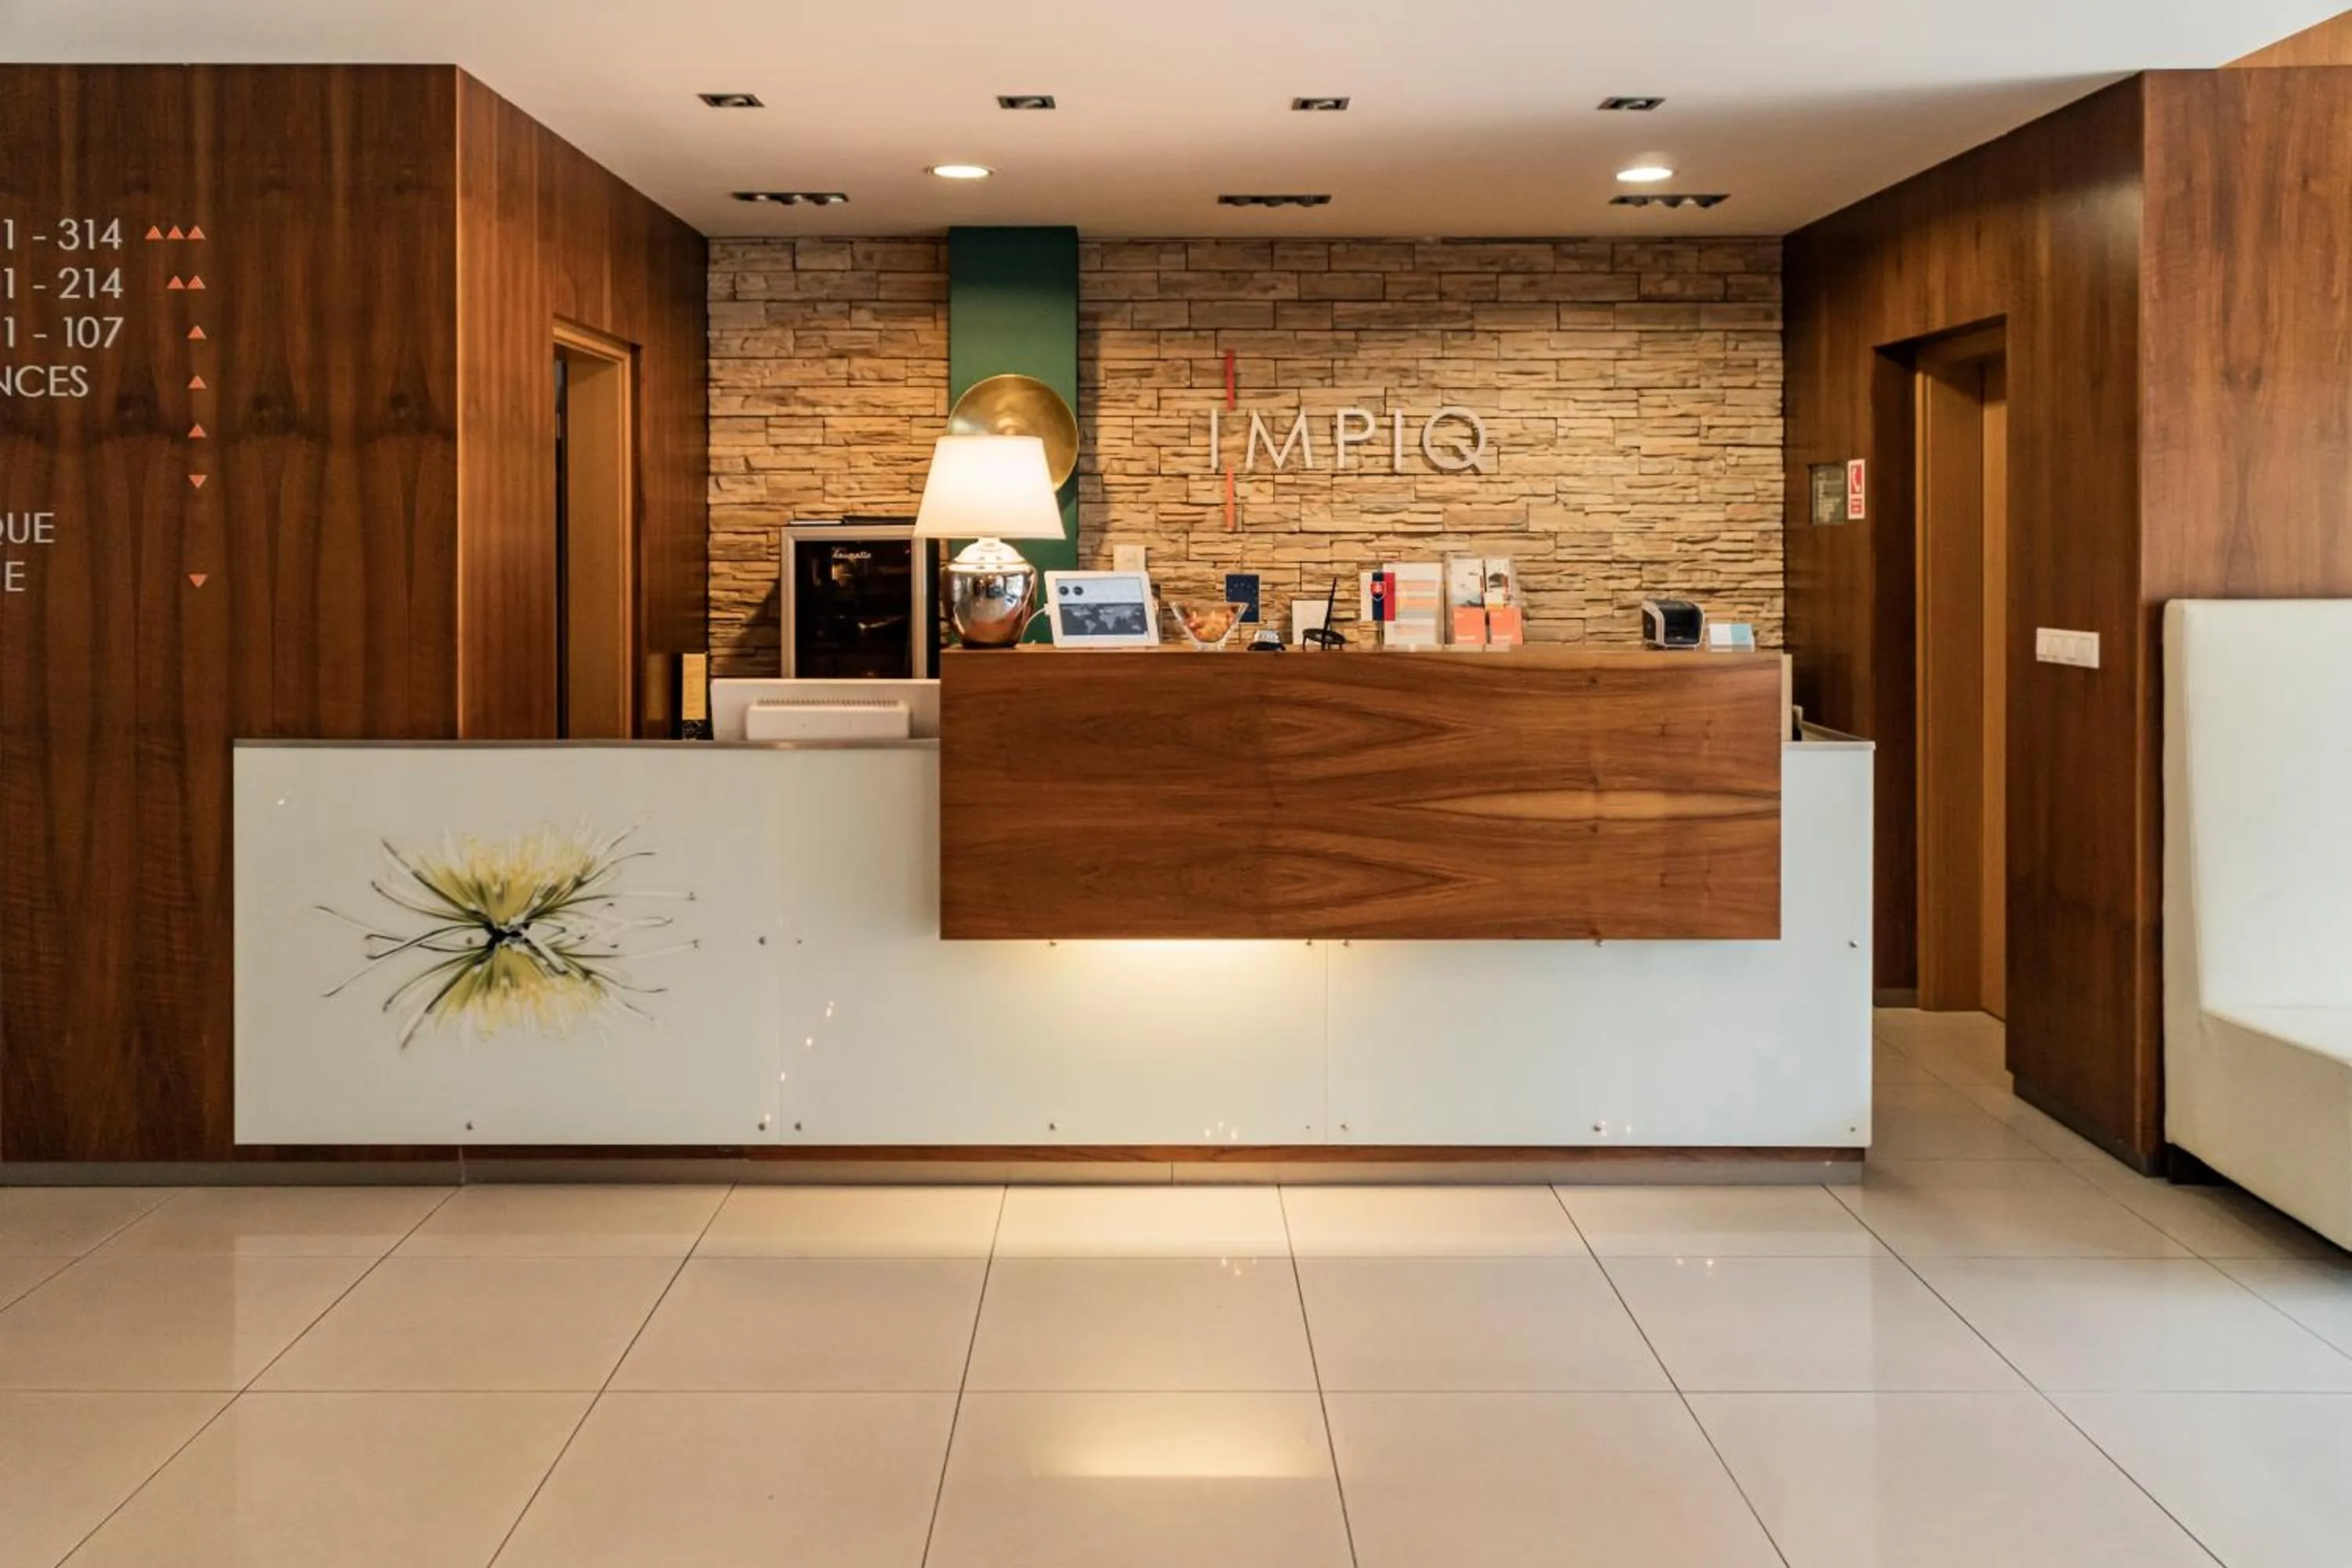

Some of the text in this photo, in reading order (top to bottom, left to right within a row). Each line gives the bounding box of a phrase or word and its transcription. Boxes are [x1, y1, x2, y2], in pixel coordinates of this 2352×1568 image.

[57, 218, 123, 250] 314
[58, 267, 124, 299] 214
[64, 317, 124, 348] 107
[1210, 406, 1486, 475] IMPIQ
[0, 512, 56, 544] UE
